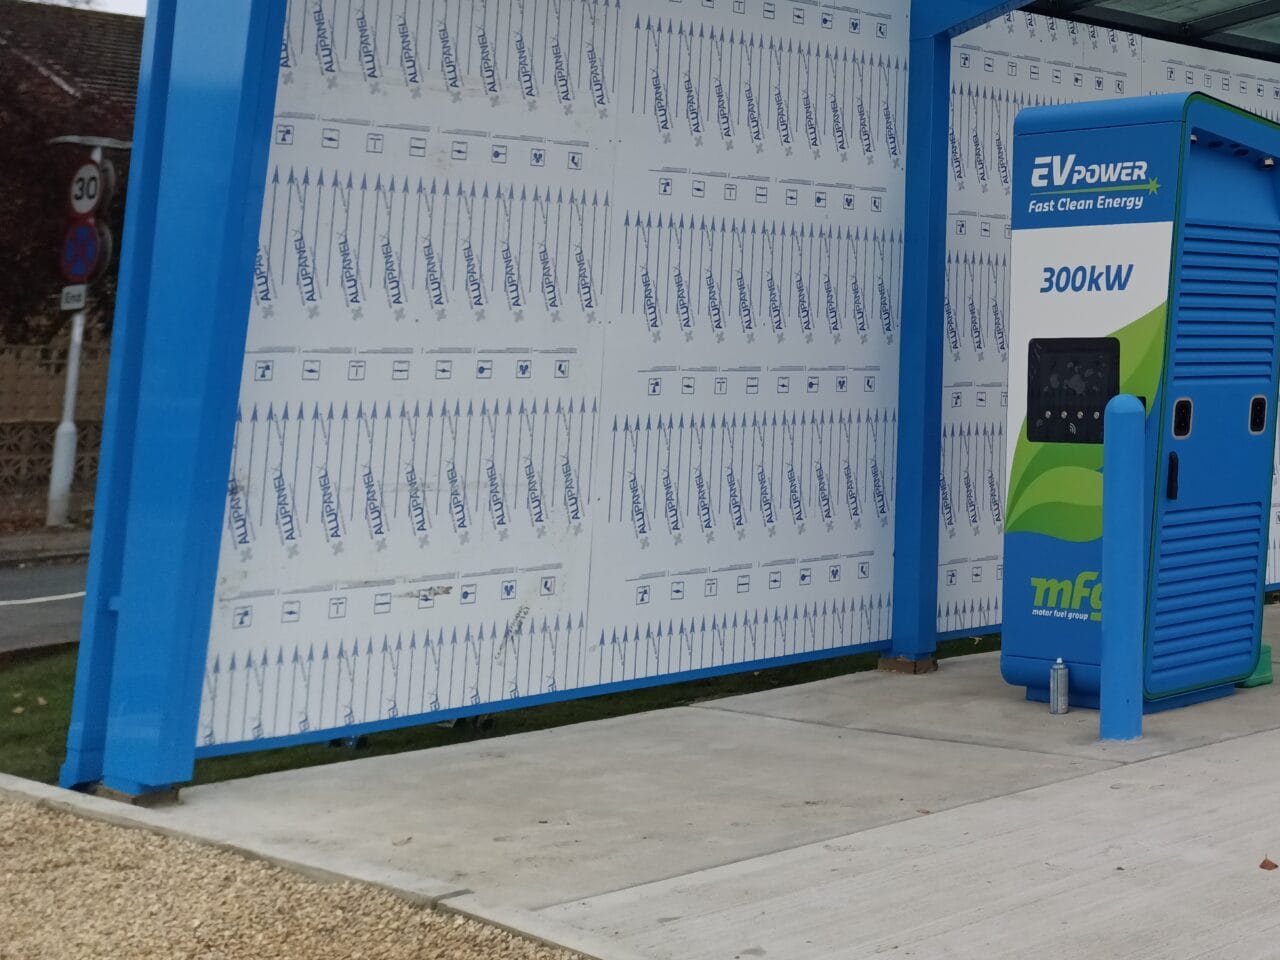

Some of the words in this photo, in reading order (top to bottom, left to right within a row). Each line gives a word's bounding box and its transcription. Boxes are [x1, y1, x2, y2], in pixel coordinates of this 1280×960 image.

[74, 177, 98, 200] 30
[1028, 199, 1055, 213] Fast
[1057, 197, 1093, 211] Clean
[1097, 195, 1144, 210] Energy
[1040, 264, 1134, 293] 300kW
[1067, 612, 1088, 620] group
